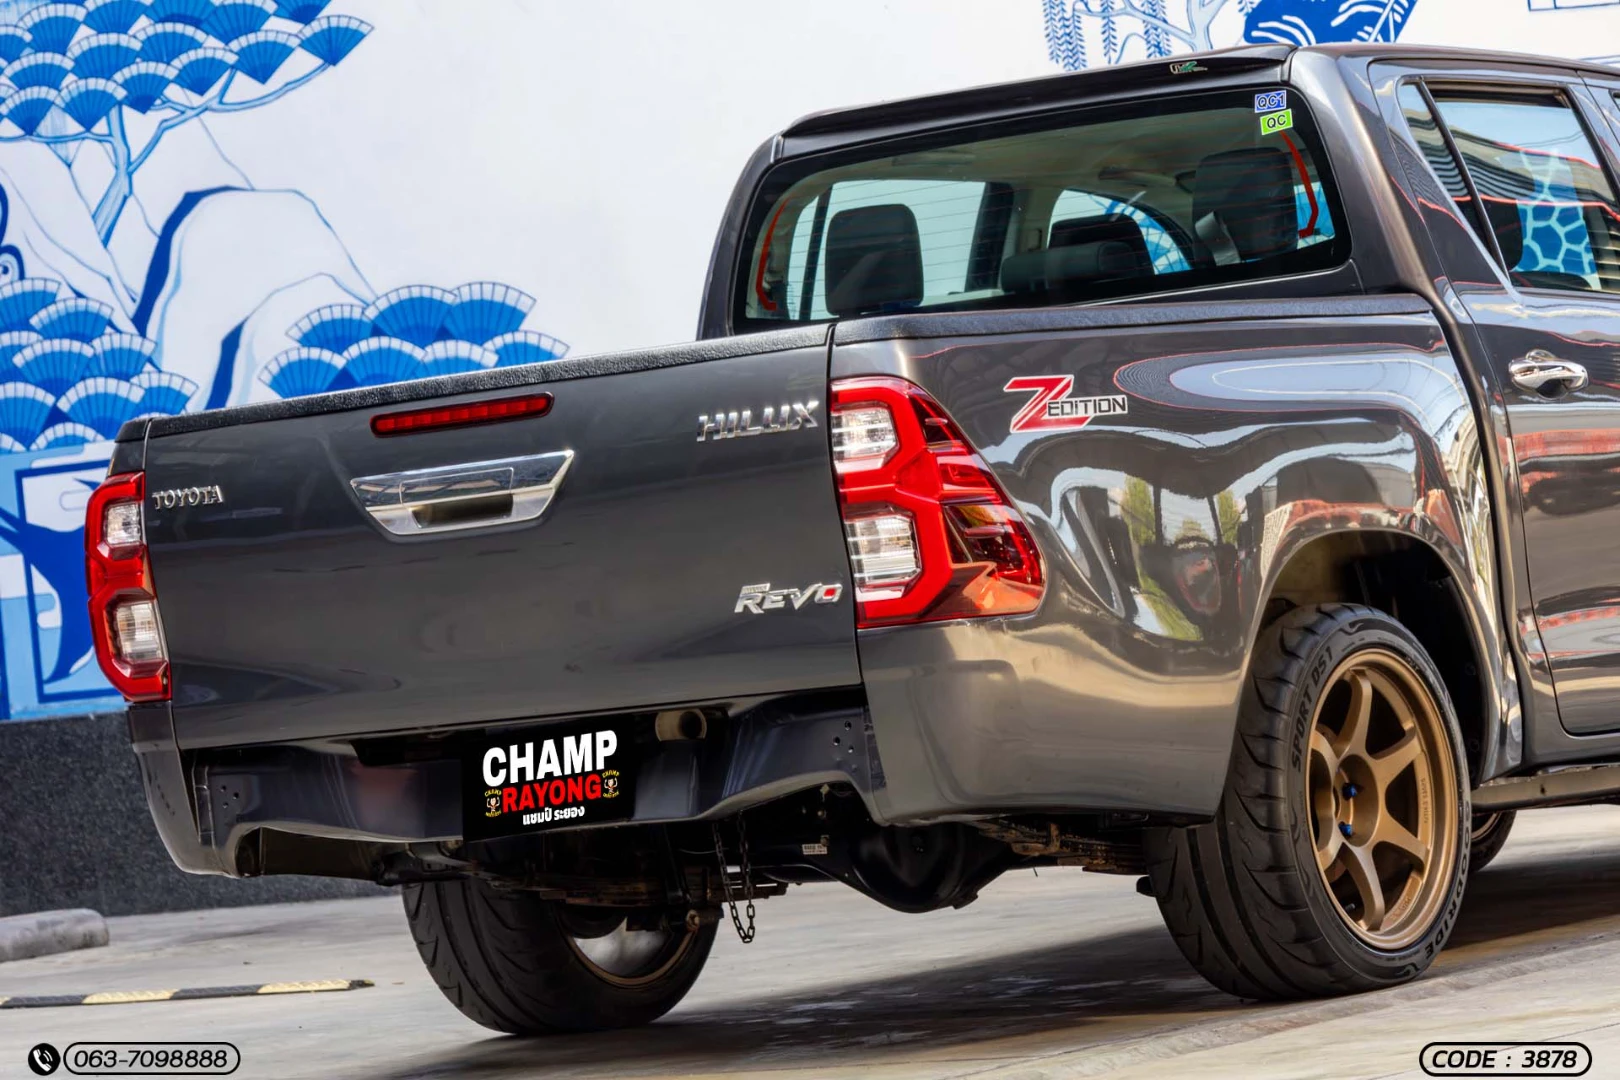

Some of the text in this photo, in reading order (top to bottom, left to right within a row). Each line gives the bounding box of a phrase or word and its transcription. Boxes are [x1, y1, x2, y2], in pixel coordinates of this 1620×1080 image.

[1257, 94, 1285, 109] QC1
[1266, 114, 1287, 129] QC
[696, 400, 820, 442] HILUX
[152, 485, 224, 510] TOYOTA
[734, 582, 844, 614] REVO
[1292, 646, 1333, 773] SPORT DS1
[482, 729, 618, 787] CHAMP
[502, 773, 602, 814] RAYONG
[554, 805, 586, 821] ระยอง
